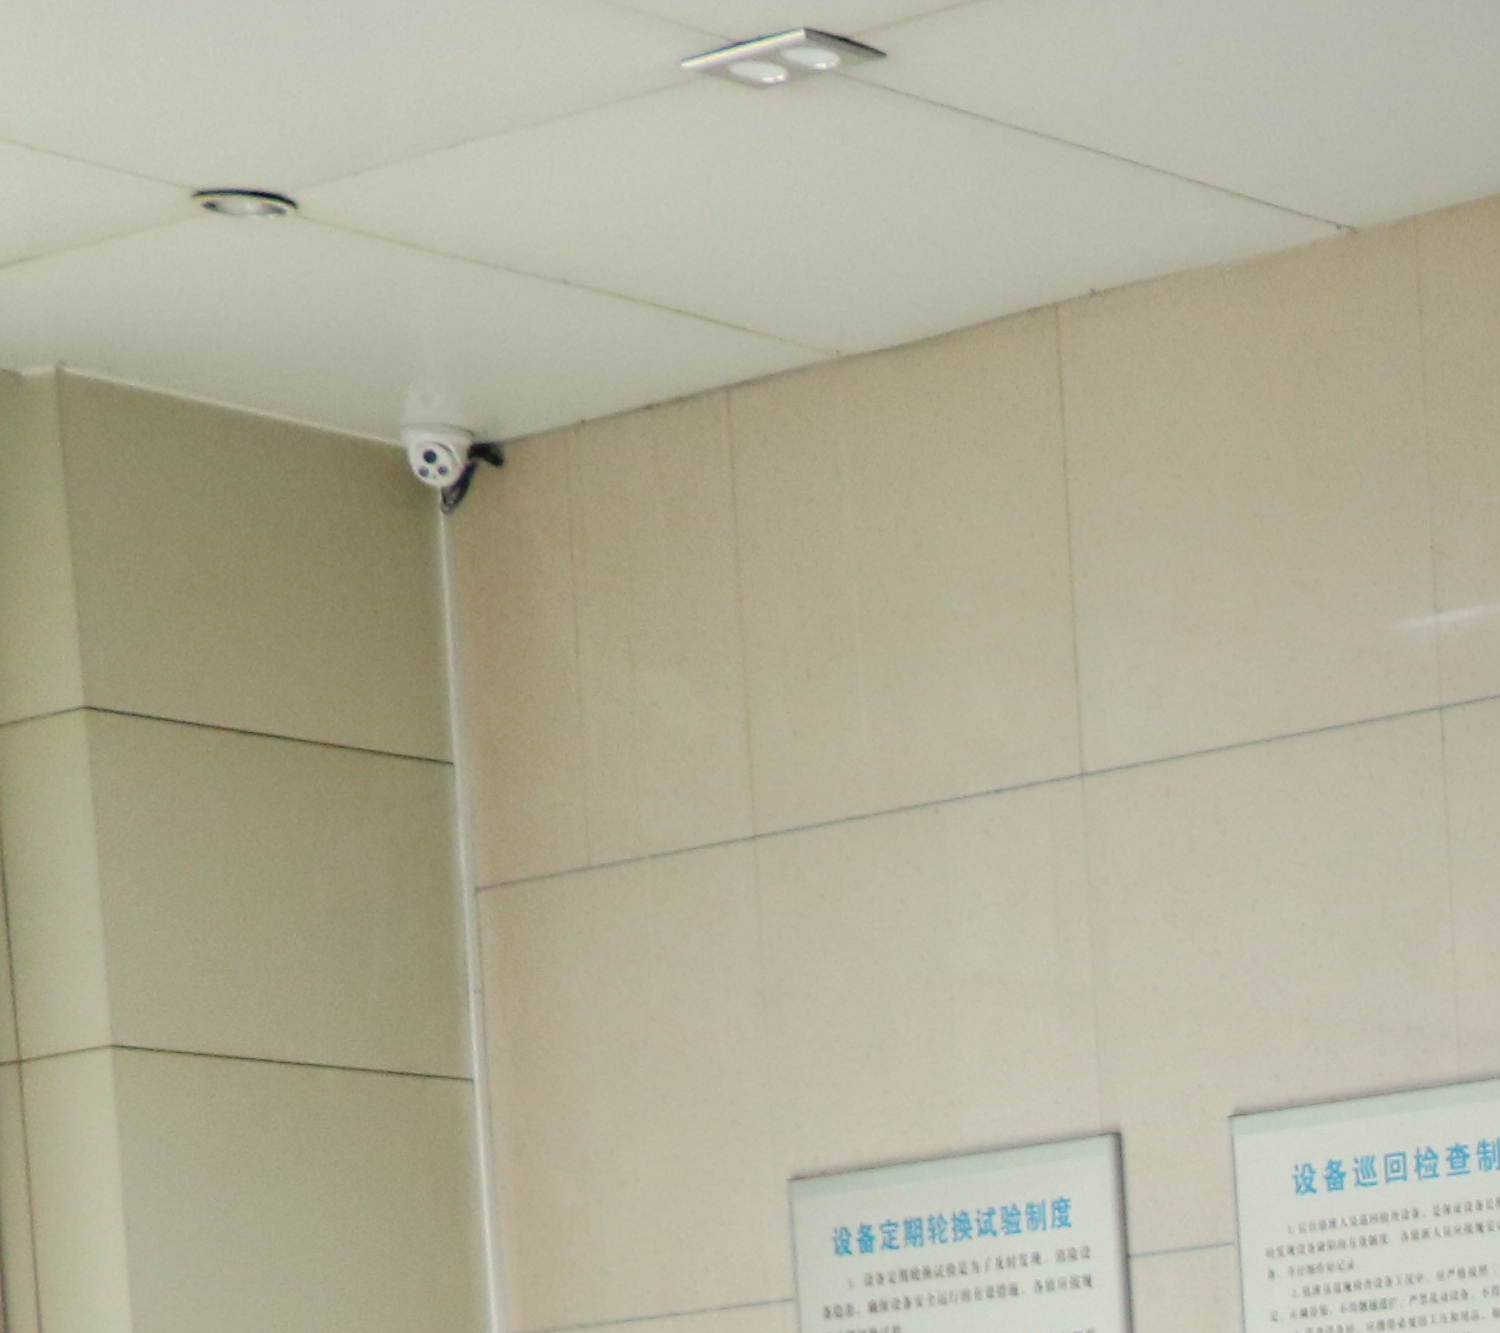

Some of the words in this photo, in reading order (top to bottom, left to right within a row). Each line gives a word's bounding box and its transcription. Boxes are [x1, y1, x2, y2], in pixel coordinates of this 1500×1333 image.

[833, 1196, 1072, 1258] 设备定期轮换试验制度
